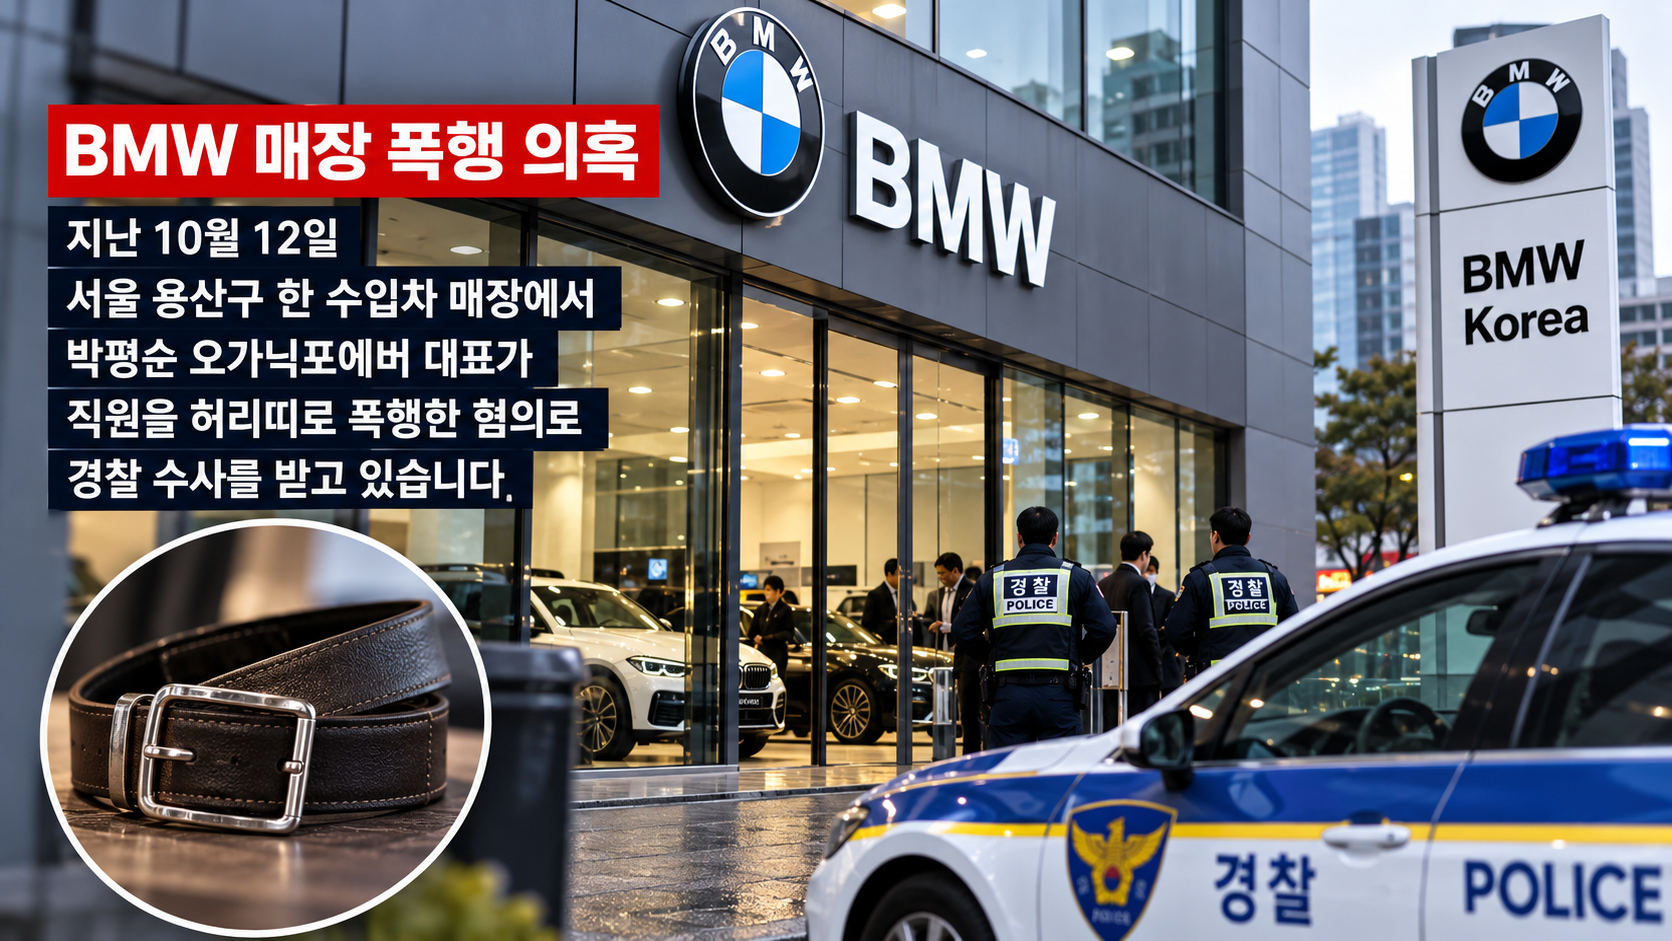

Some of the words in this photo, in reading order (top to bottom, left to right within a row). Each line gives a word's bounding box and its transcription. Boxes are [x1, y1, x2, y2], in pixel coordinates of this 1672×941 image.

[710, 15, 814, 93] BMW
[1471, 60, 1571, 108] BMW
[850, 109, 1057, 288] BMW
[1463, 239, 1585, 294] BMW
[1464, 304, 1589, 346] Korea
[1006, 598, 1054, 611] POLICE
[1010, 576, 1051, 597] 경찰
[1227, 600, 1267, 611] POLICE
[1214, 851, 1317, 928] 경찰
[1463, 858, 1664, 926] POLICE
